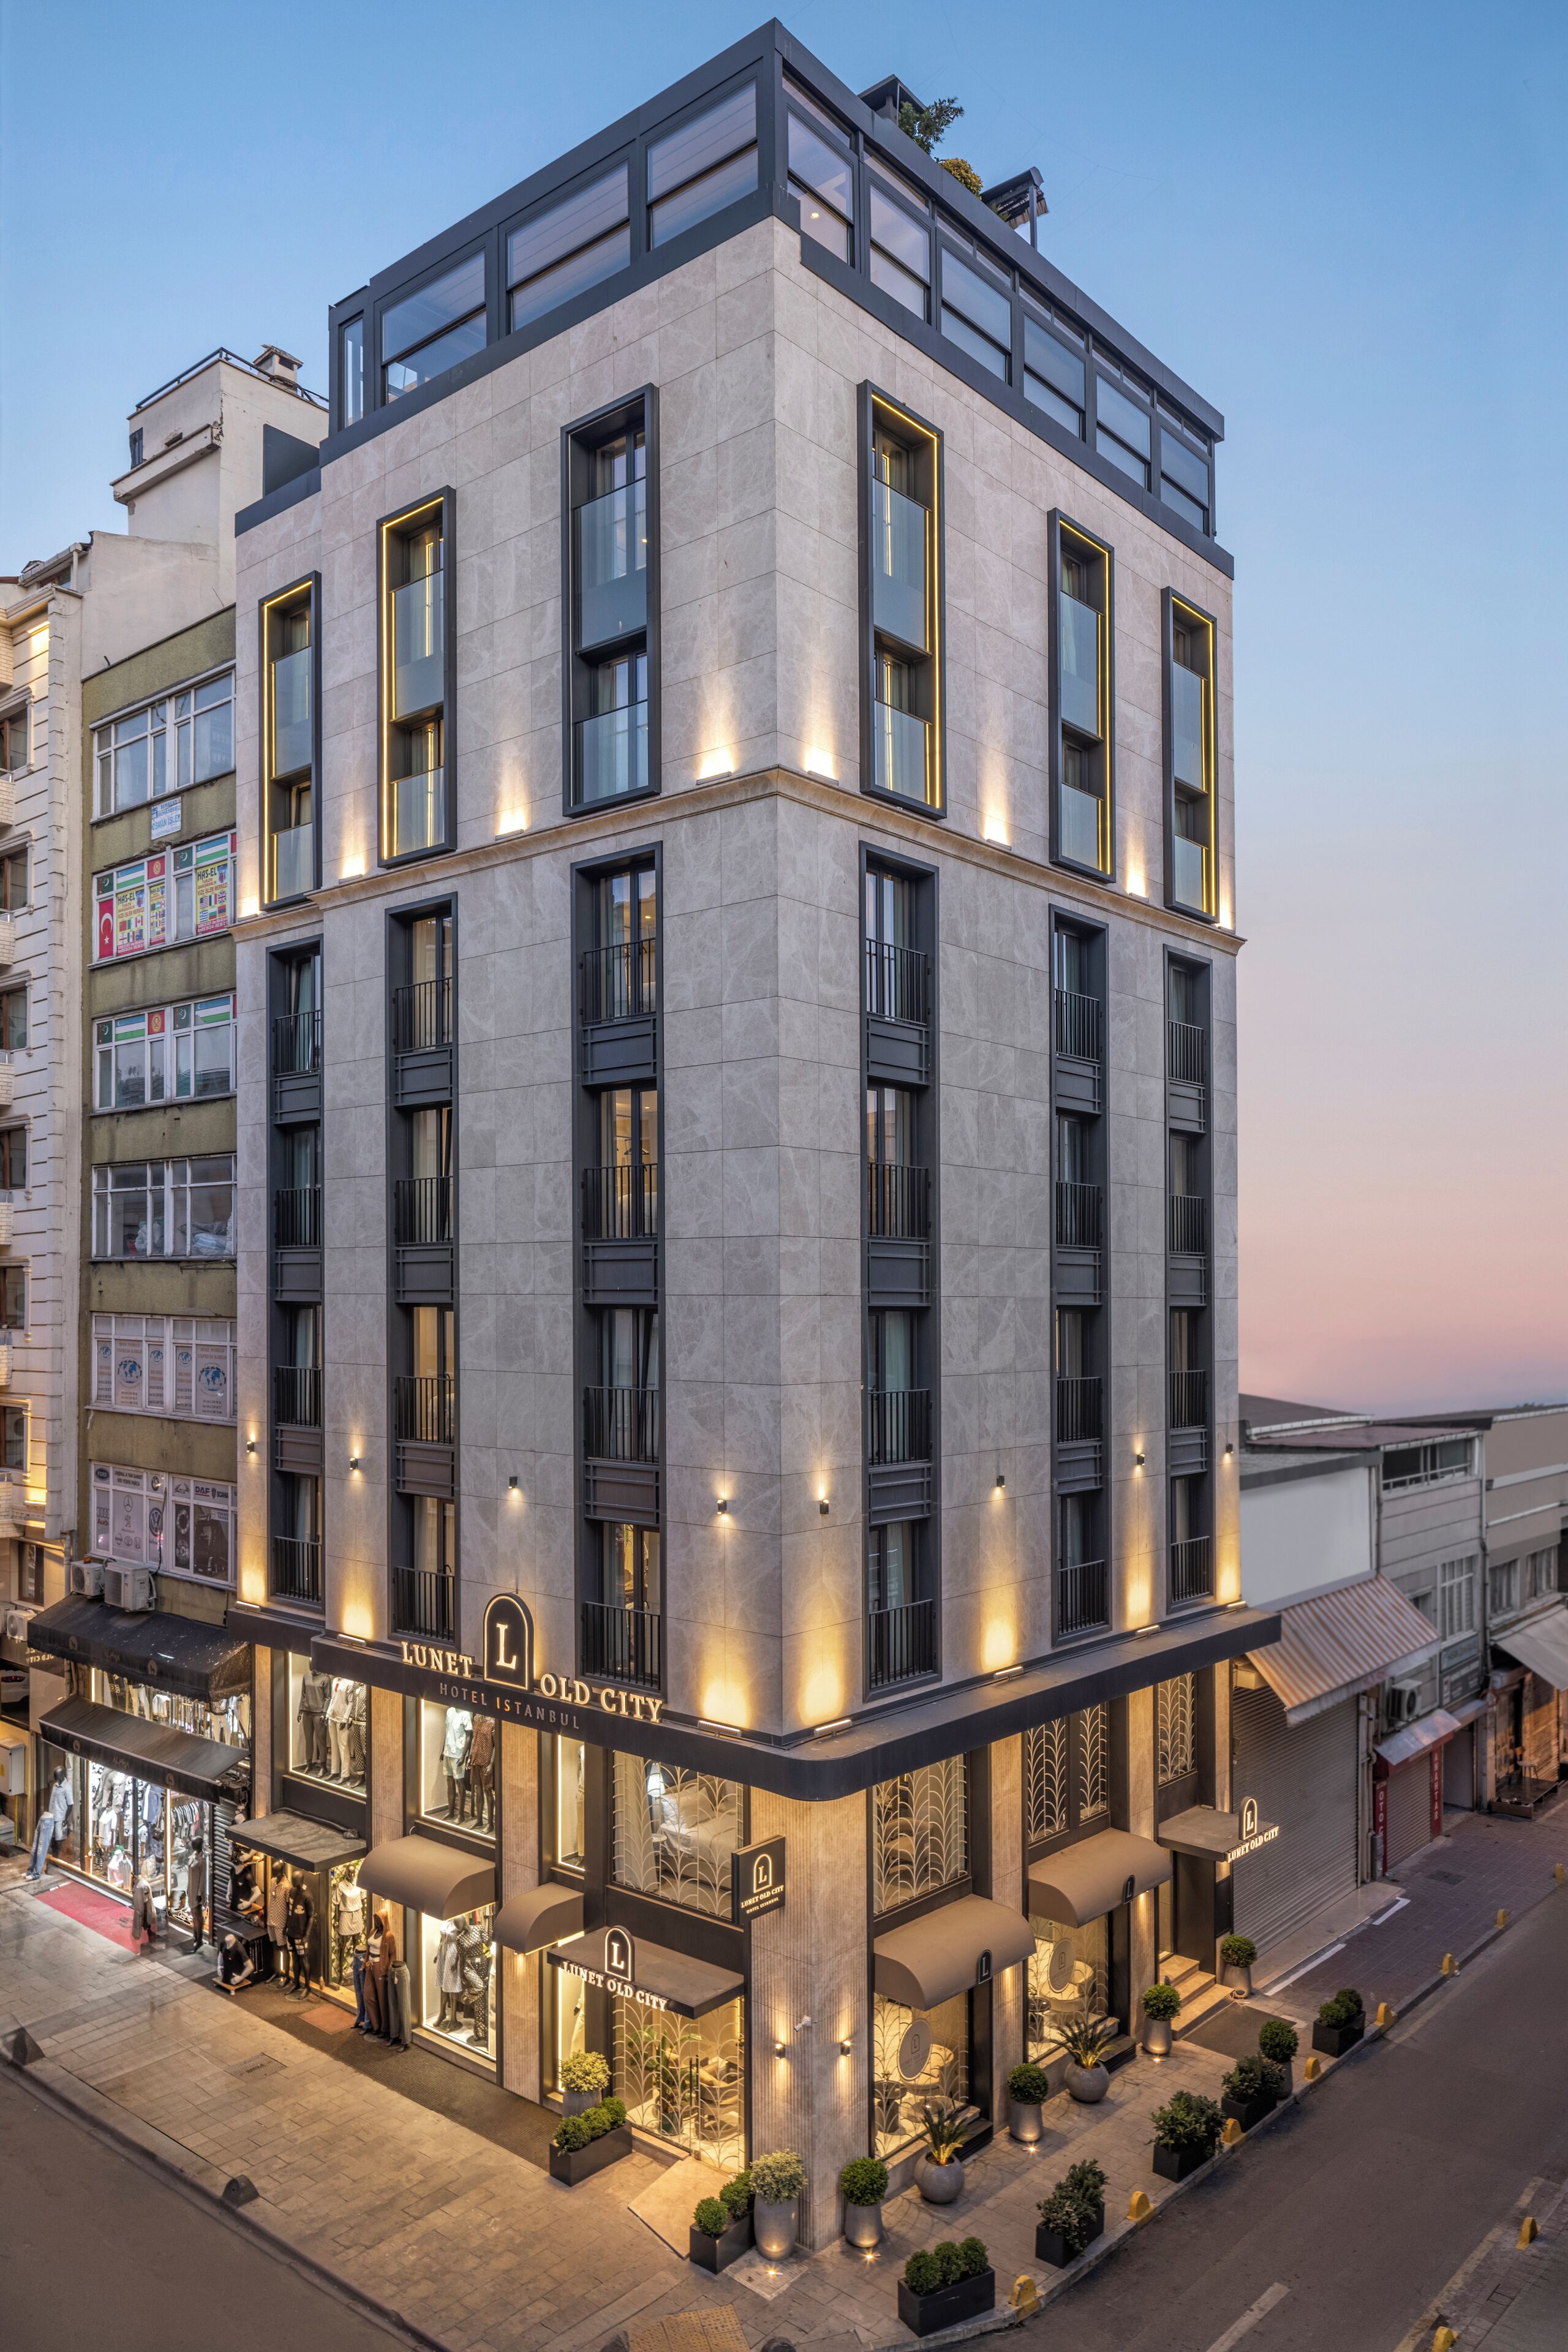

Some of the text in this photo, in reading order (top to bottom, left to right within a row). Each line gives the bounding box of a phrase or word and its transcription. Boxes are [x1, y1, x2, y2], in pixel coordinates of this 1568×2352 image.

[198, 867, 217, 881] HAS-EL
[118, 892, 135, 906] HAS-EL
[195, 1486, 210, 1494] DAF
[496, 1623, 517, 1670] L
[401, 1641, 663, 1724] LUNET OLD CITY
[440, 1683, 579, 1729] HOTEL ISTANBUL
[1246, 1811, 1254, 1831] L
[1228, 1826, 1280, 1863] LUNET OLD CITY
[758, 1866, 767, 1883] L
[741, 1885, 784, 1909] LUNET OLD CITY
[746, 1897, 779, 1914] HOTEL ISTANBUL
[611, 1942, 624, 1969] L
[982, 1956, 989, 1977] L
[562, 1960, 669, 2012] LUNET OLD CITY
